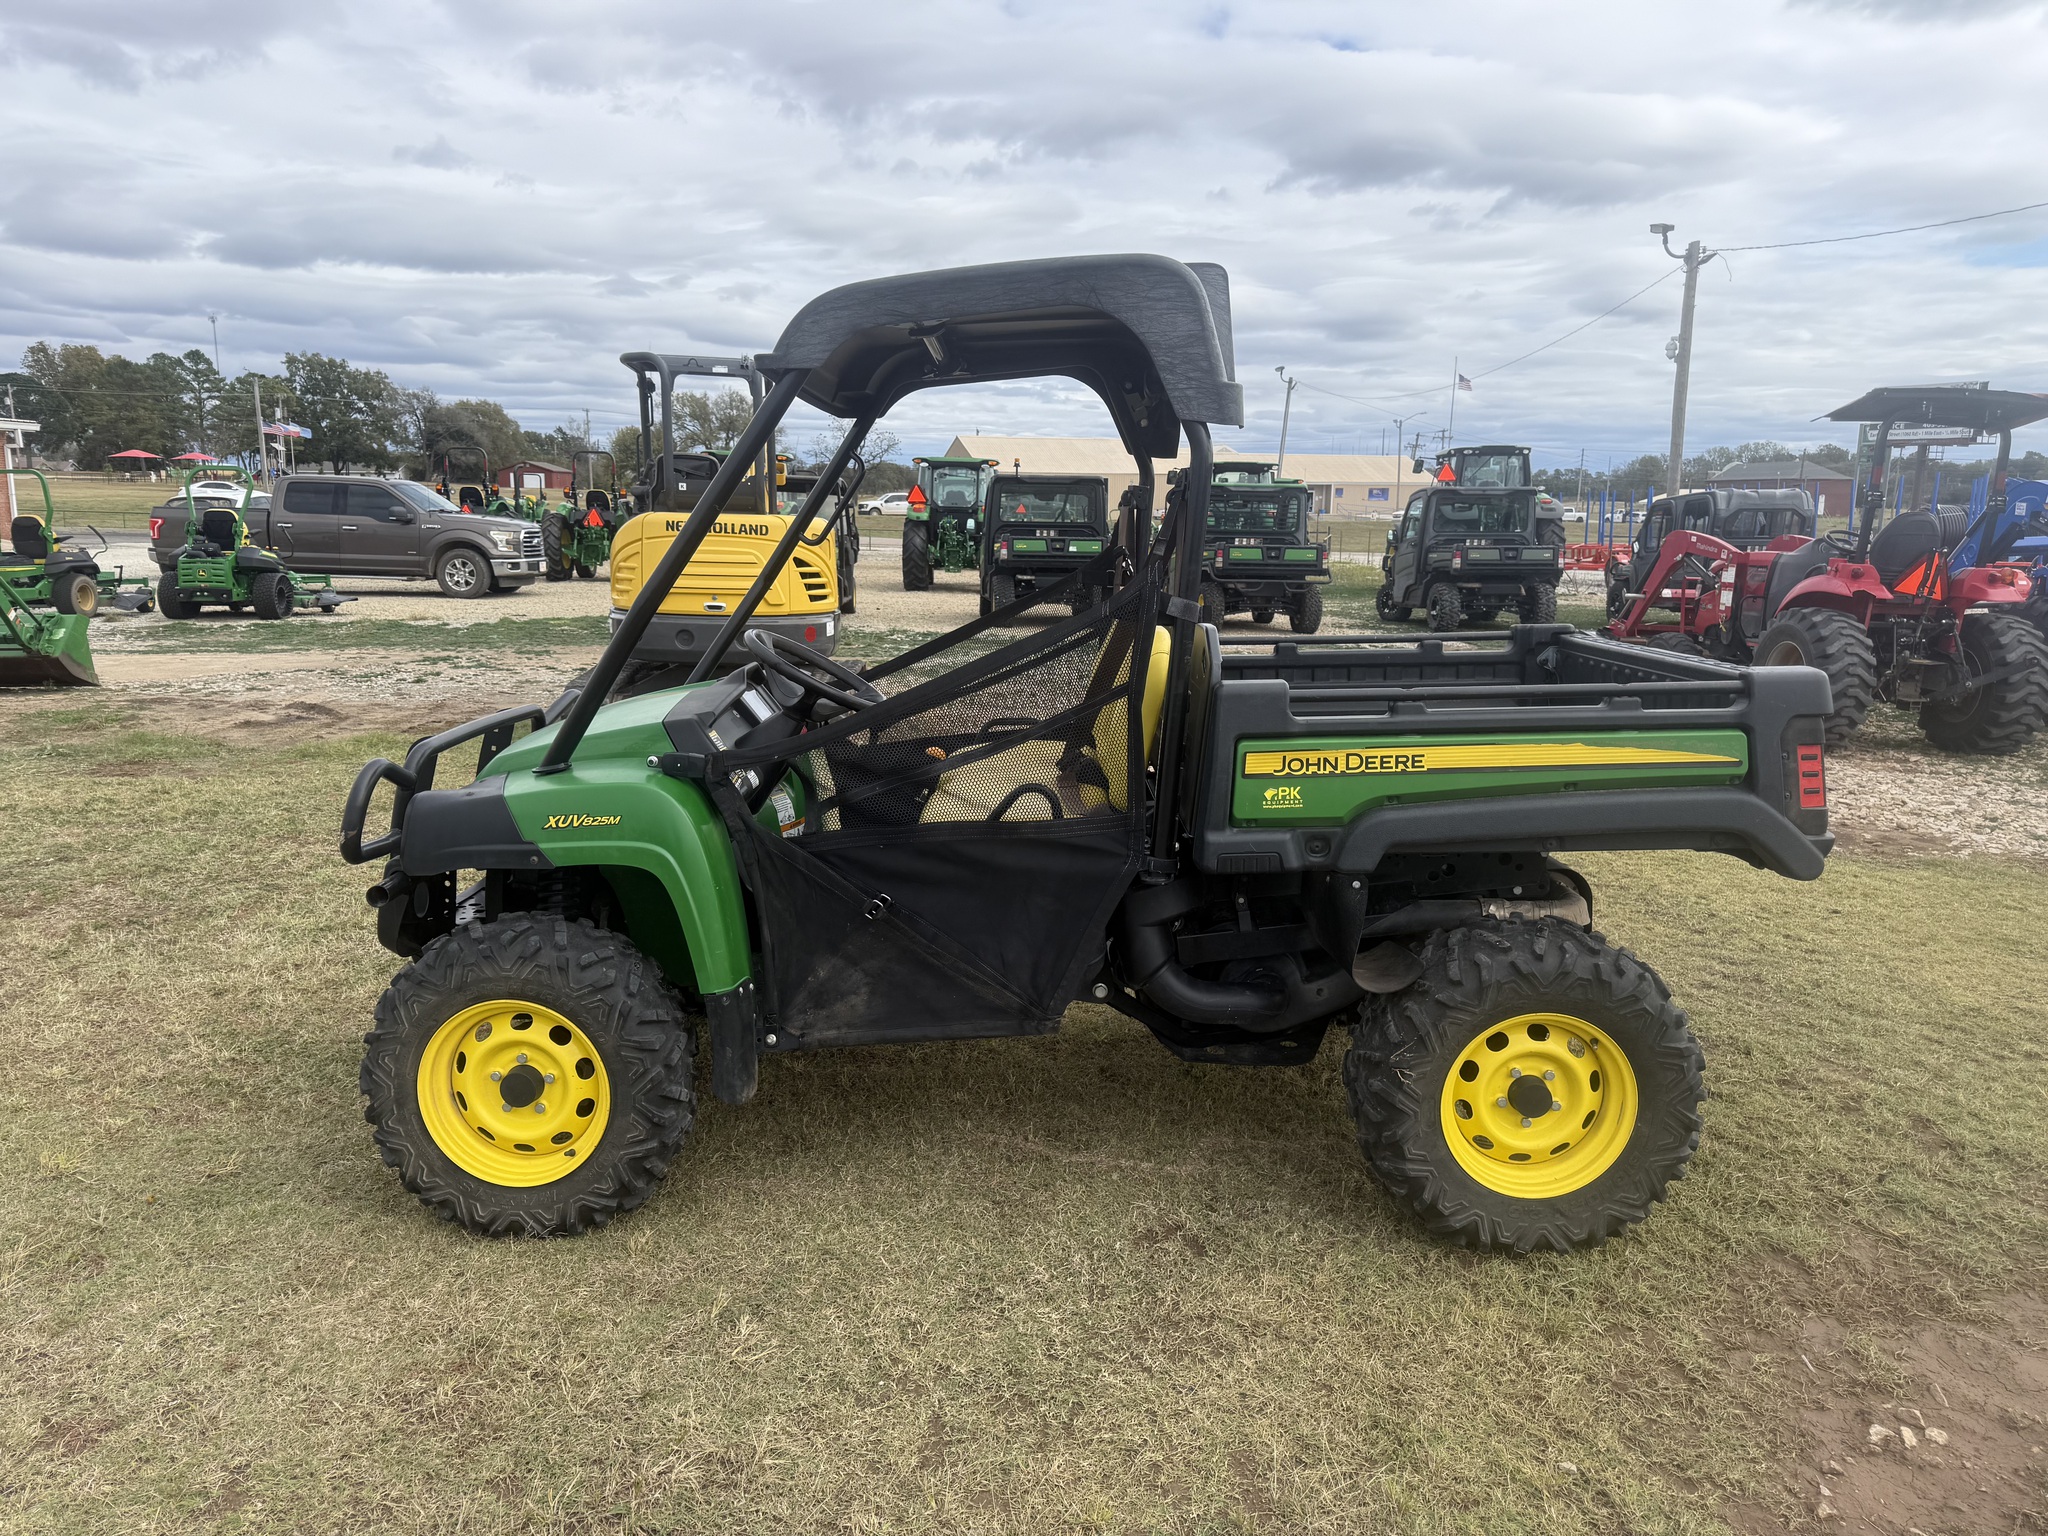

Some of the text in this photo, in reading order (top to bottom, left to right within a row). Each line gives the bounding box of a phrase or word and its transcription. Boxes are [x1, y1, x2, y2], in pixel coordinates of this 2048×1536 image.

[665, 520, 687, 532] NE
[1273, 752, 1426, 774] JOHN DEERE
